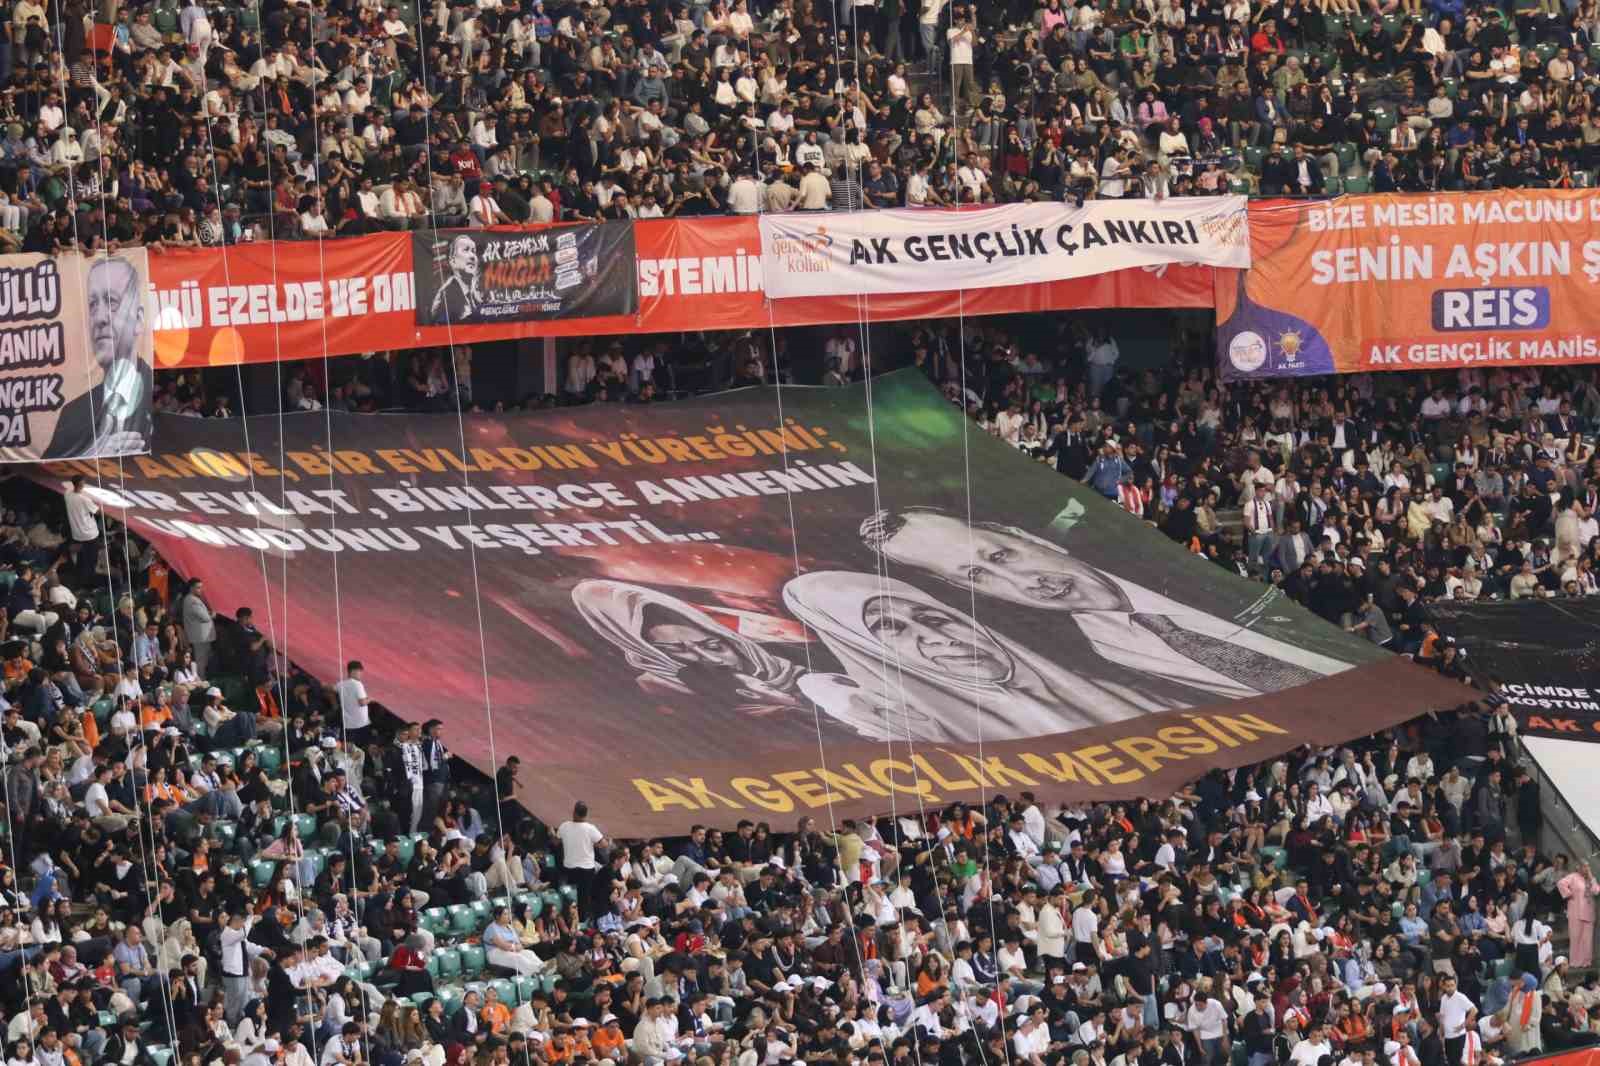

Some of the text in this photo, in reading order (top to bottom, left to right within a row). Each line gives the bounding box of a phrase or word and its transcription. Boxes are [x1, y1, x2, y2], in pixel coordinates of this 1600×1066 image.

[1308, 202, 1366, 232] BİZE
[1373, 197, 1455, 228] MESİR
[1463, 198, 1583, 225] MACUNU
[850, 237, 898, 265] AK
[904, 223, 1049, 264] GENÇLİK
[1056, 217, 1200, 257] ÇANKIRI
[1311, 235, 1433, 285] SENİN
[1446, 239, 1570, 286] AŞKIN
[636, 247, 765, 297] STEMİN
[208, 281, 325, 327] EZELDE
[329, 276, 368, 318] VE
[1443, 288, 1538, 328] REİS
[0, 326, 60, 366] ANIM
[1369, 335, 1600, 367] AK GENÇLİK MANİS
[286, 444, 385, 476] BİR
[375, 444, 598, 474] EVLADIN
[635, 459, 877, 506] ANNENİN
[132, 515, 421, 552] UMUDUNU
[1529, 715, 1585, 733] AK
[631, 712, 1289, 813] AK GENÇLİK MERSİN
